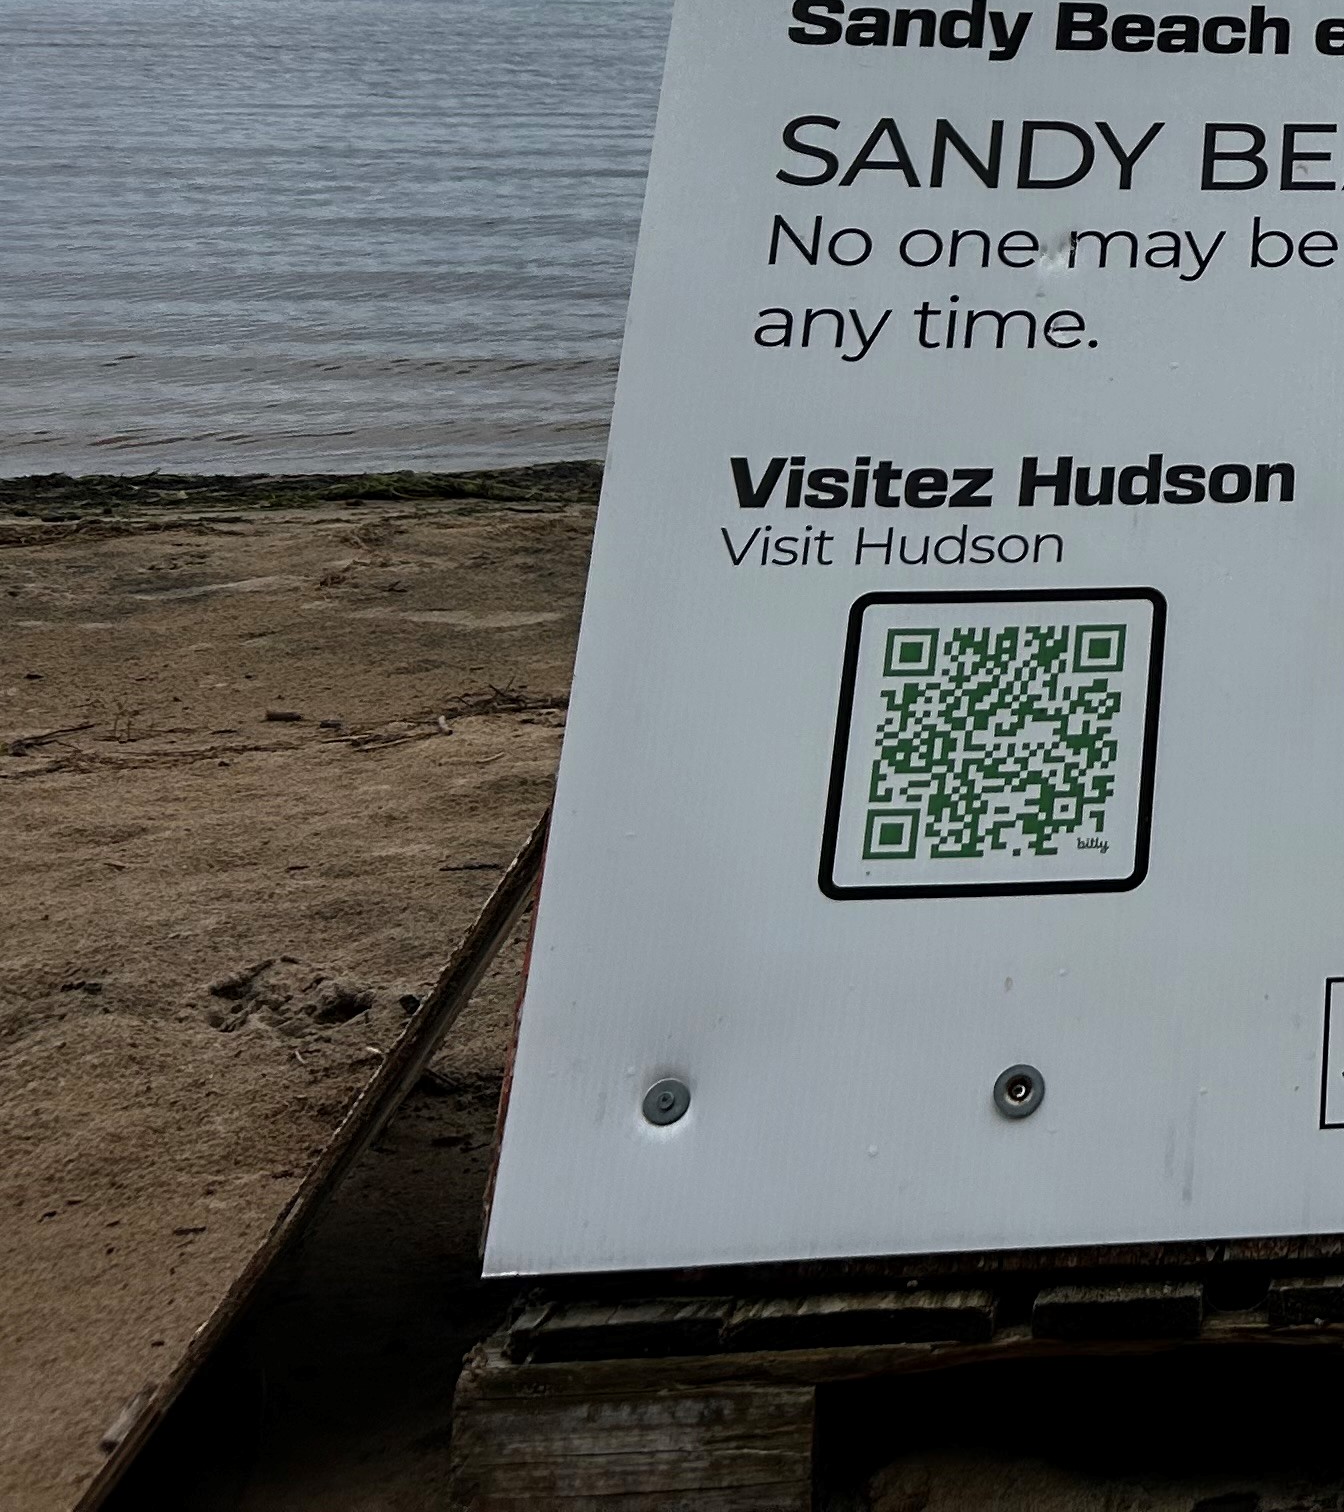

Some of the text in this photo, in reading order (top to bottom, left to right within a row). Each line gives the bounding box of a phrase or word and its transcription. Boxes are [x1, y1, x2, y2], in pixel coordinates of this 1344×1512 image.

[1056, 2, 1289, 54] Beach
[776, 116, 1165, 189] SANDY
[769, 215, 872, 266] No
[900, 230, 1039, 267] one
[1069, 231, 1225, 281] may
[1251, 217, 1338, 267] be
[755, 295, 1097, 362] any time.
[731, 454, 1294, 508] Visitez Hudson
[721, 524, 1063, 565] Visit Hudson
